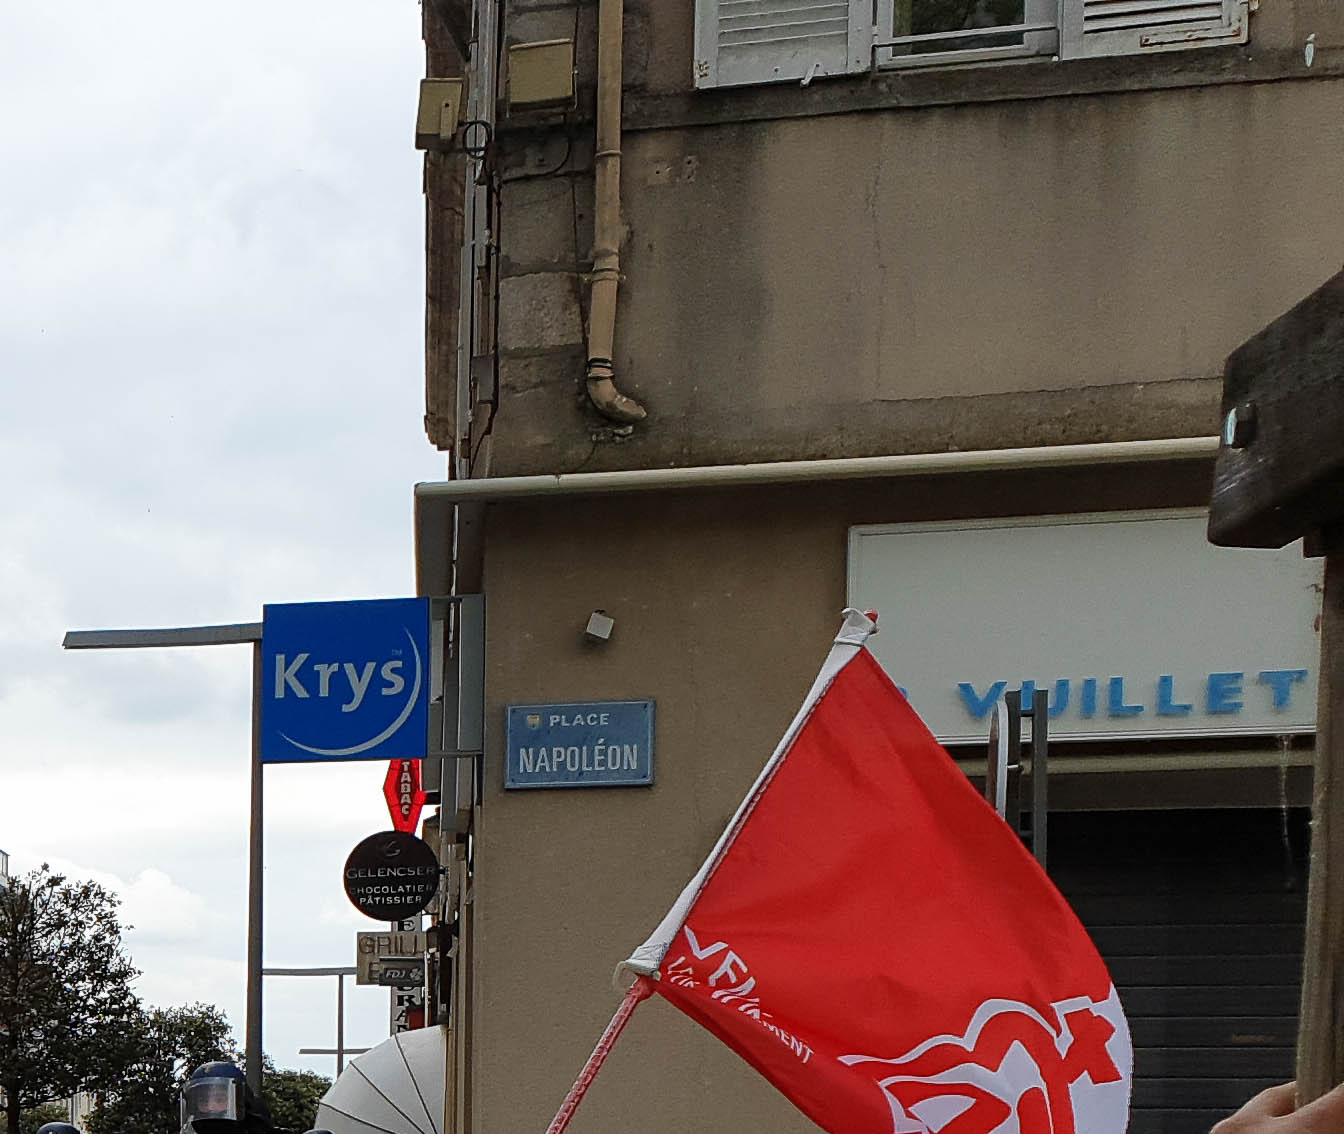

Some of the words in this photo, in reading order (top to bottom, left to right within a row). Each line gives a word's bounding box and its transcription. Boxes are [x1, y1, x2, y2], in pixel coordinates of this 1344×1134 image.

[275, 653, 405, 712] Krys
[956, 669, 1309, 718] VUILLET
[549, 713, 610, 727] PLACE
[519, 738, 638, 773] NAPOLÉON
[400, 761, 412, 815] TABAC
[346, 866, 435, 879] GELENCSER
[386, 969, 406, 978] FDJ
